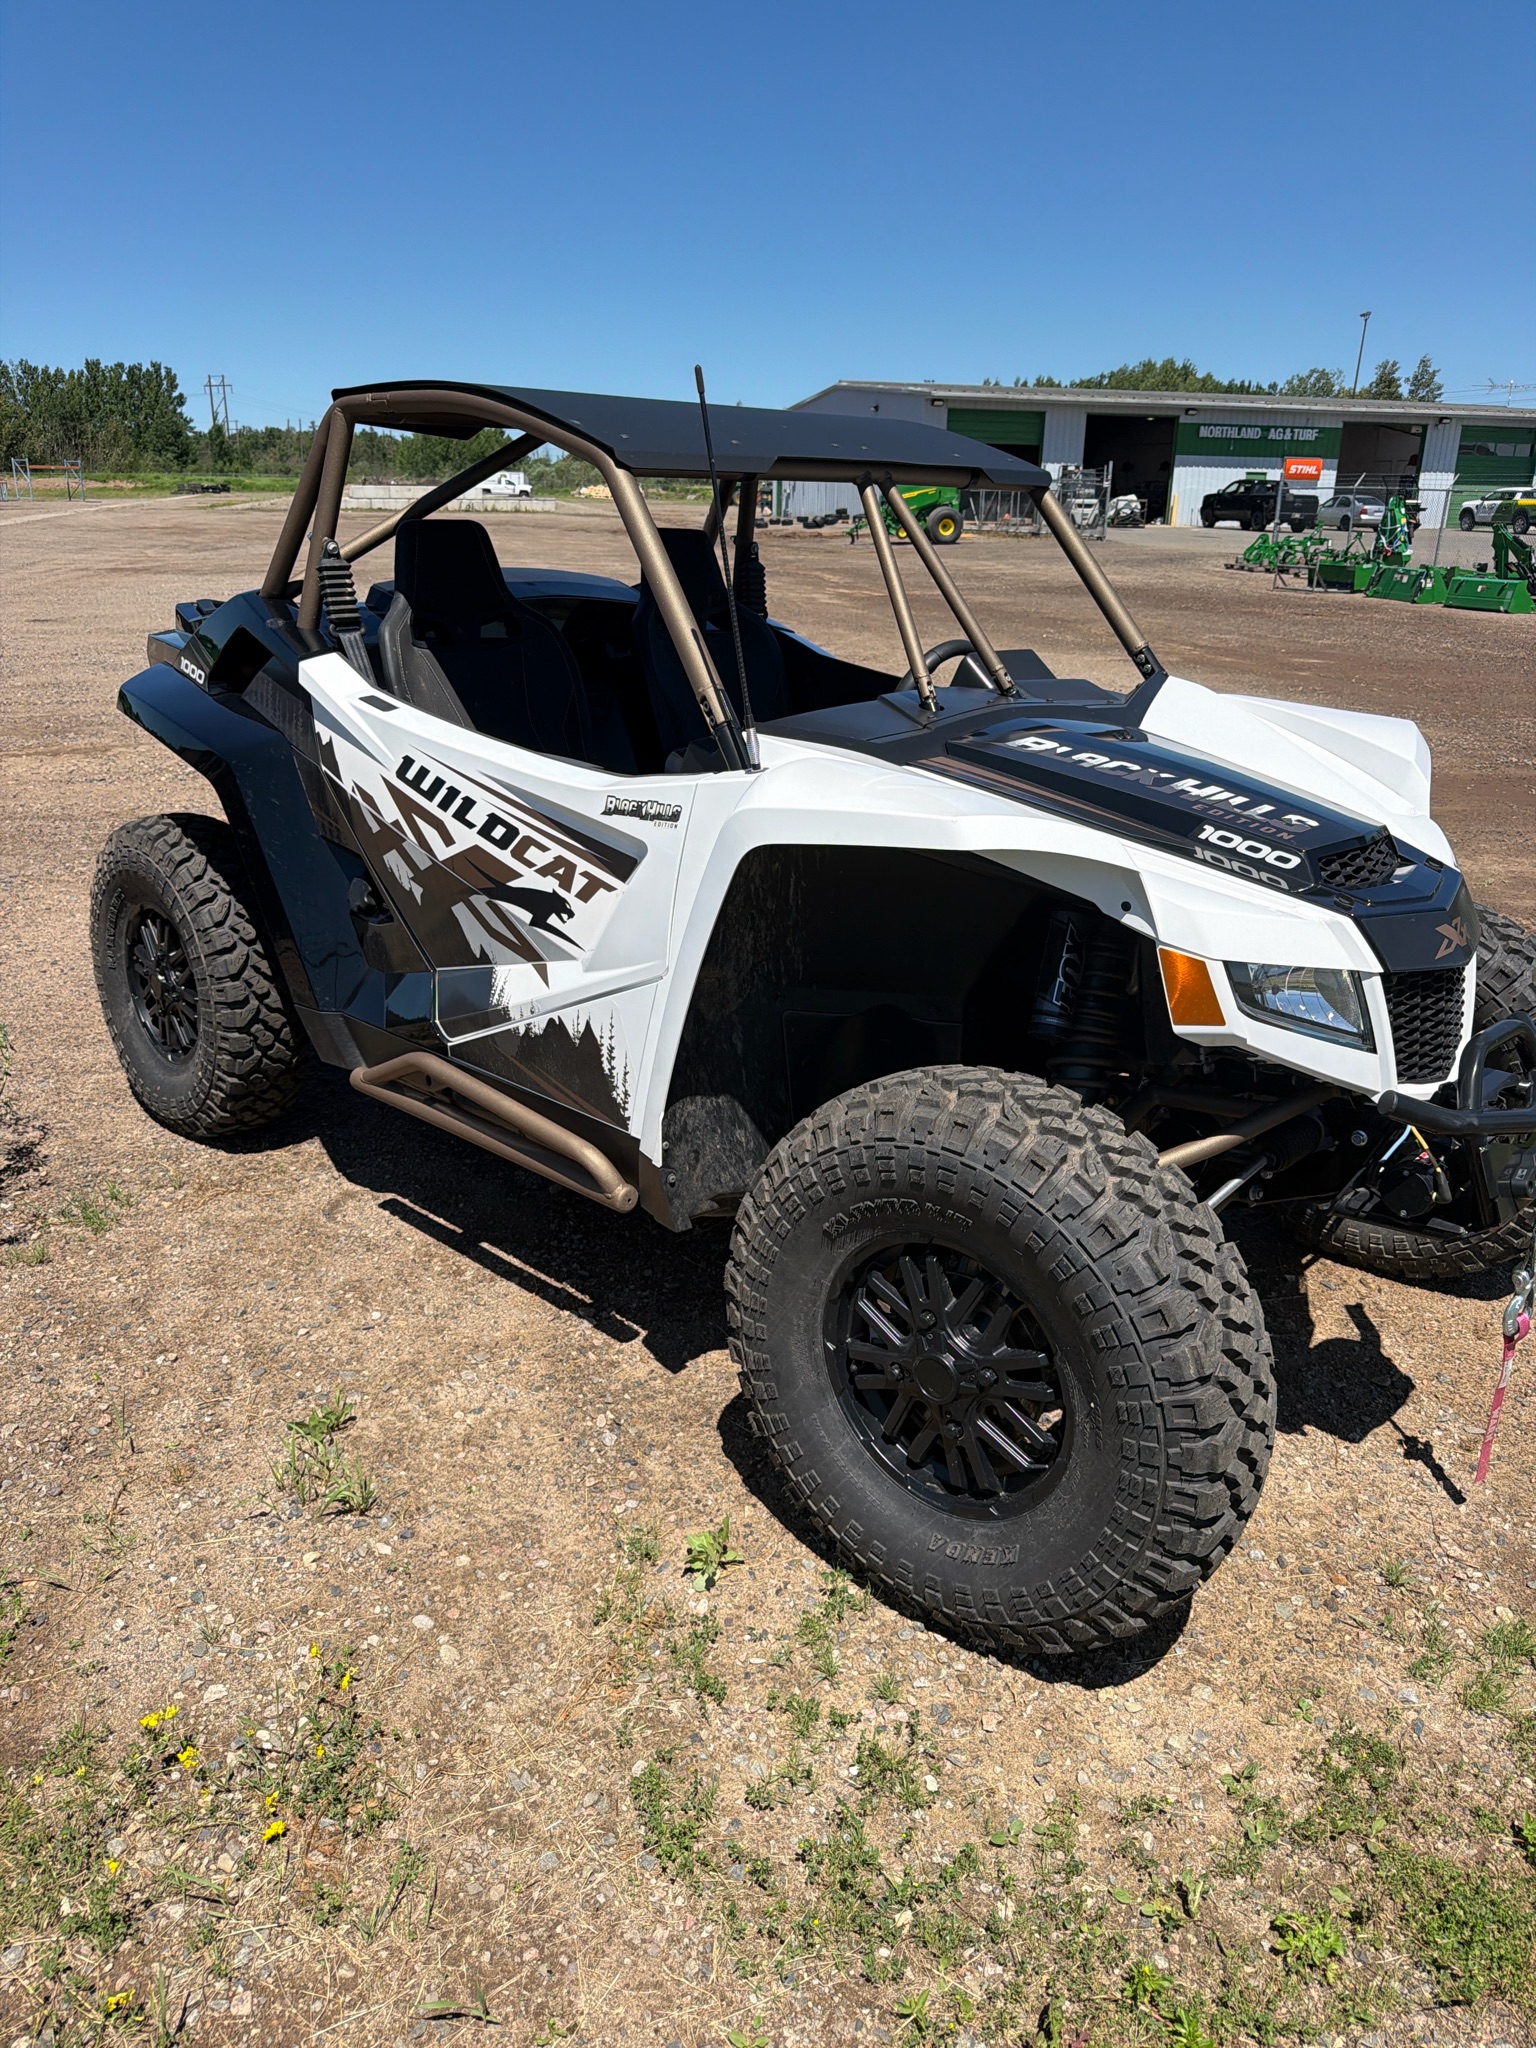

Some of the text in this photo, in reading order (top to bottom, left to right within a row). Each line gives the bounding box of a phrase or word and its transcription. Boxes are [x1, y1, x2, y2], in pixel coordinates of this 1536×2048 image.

[1199, 425, 1262, 439] NORTHLAND
[1288, 464, 1319, 475] STIHL
[180, 655, 206, 685] 1000
[395, 754, 619, 904] WILDCAT
[653, 821, 679, 829] EDITION
[1191, 803, 1298, 841] EDITION
[1197, 824, 1302, 870] 1000
[1052, 921, 1086, 1015] FOX
[926, 1531, 1020, 1567] KENDA
